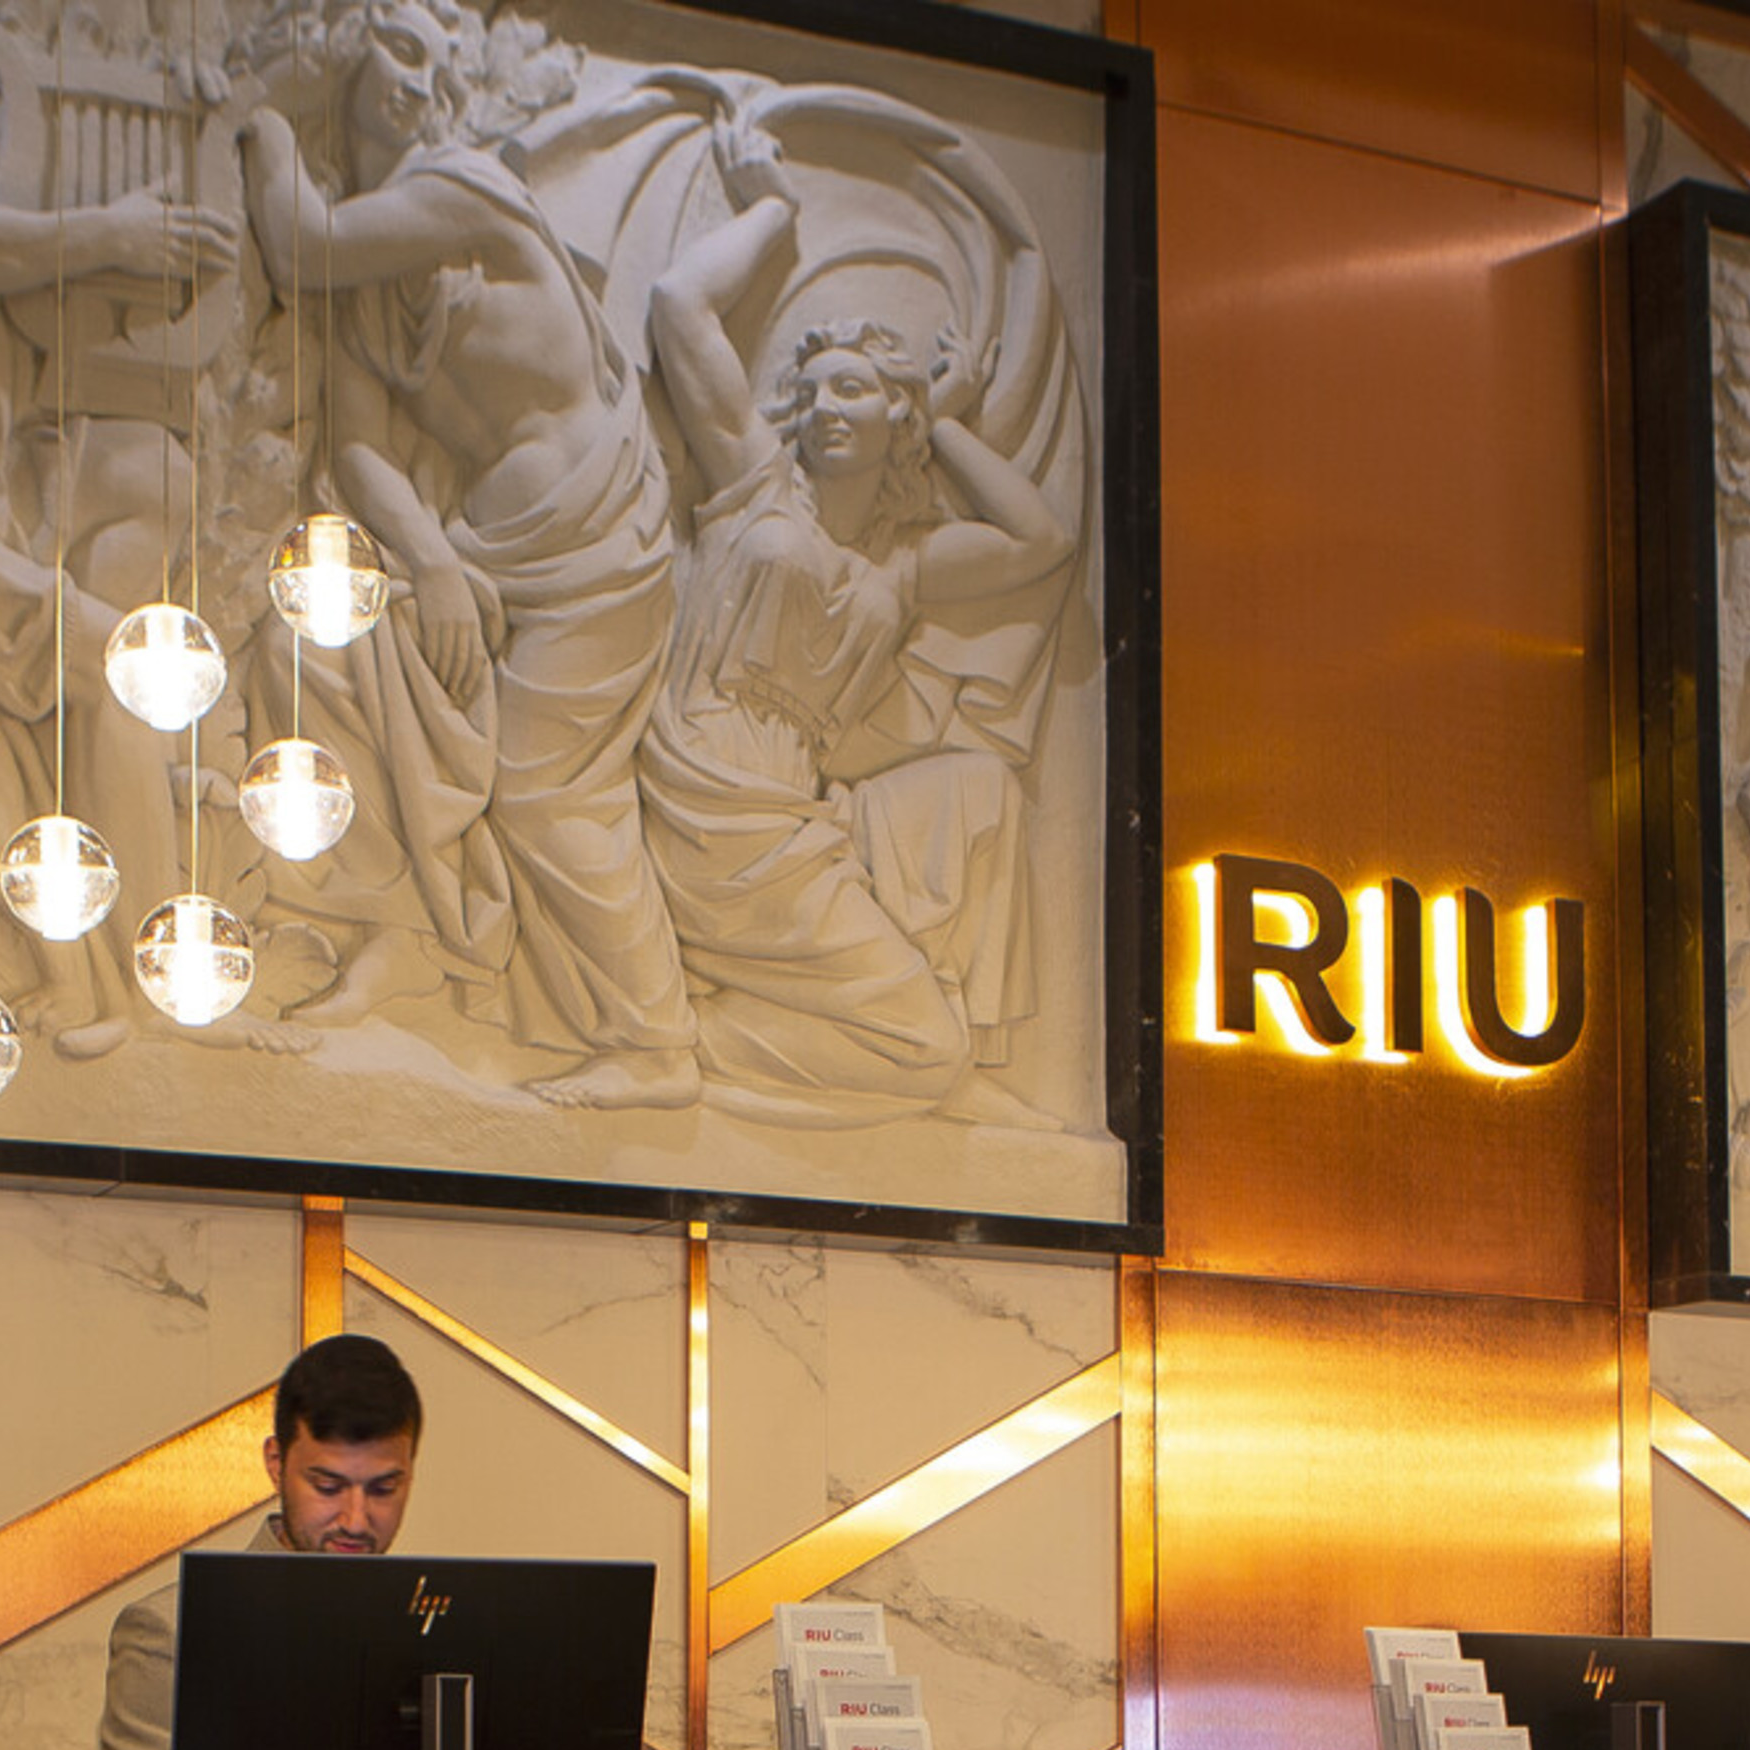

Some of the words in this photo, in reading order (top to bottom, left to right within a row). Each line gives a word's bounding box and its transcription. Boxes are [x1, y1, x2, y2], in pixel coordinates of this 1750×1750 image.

[1213, 853, 1586, 1068] RIU
[408, 1574, 451, 1635] hp
[805, 1629, 831, 1642] RIU
[833, 1629, 864, 1642] Class
[1583, 1649, 1616, 1701] hp
[840, 1703, 867, 1716] RIU
[869, 1703, 900, 1716] Class
